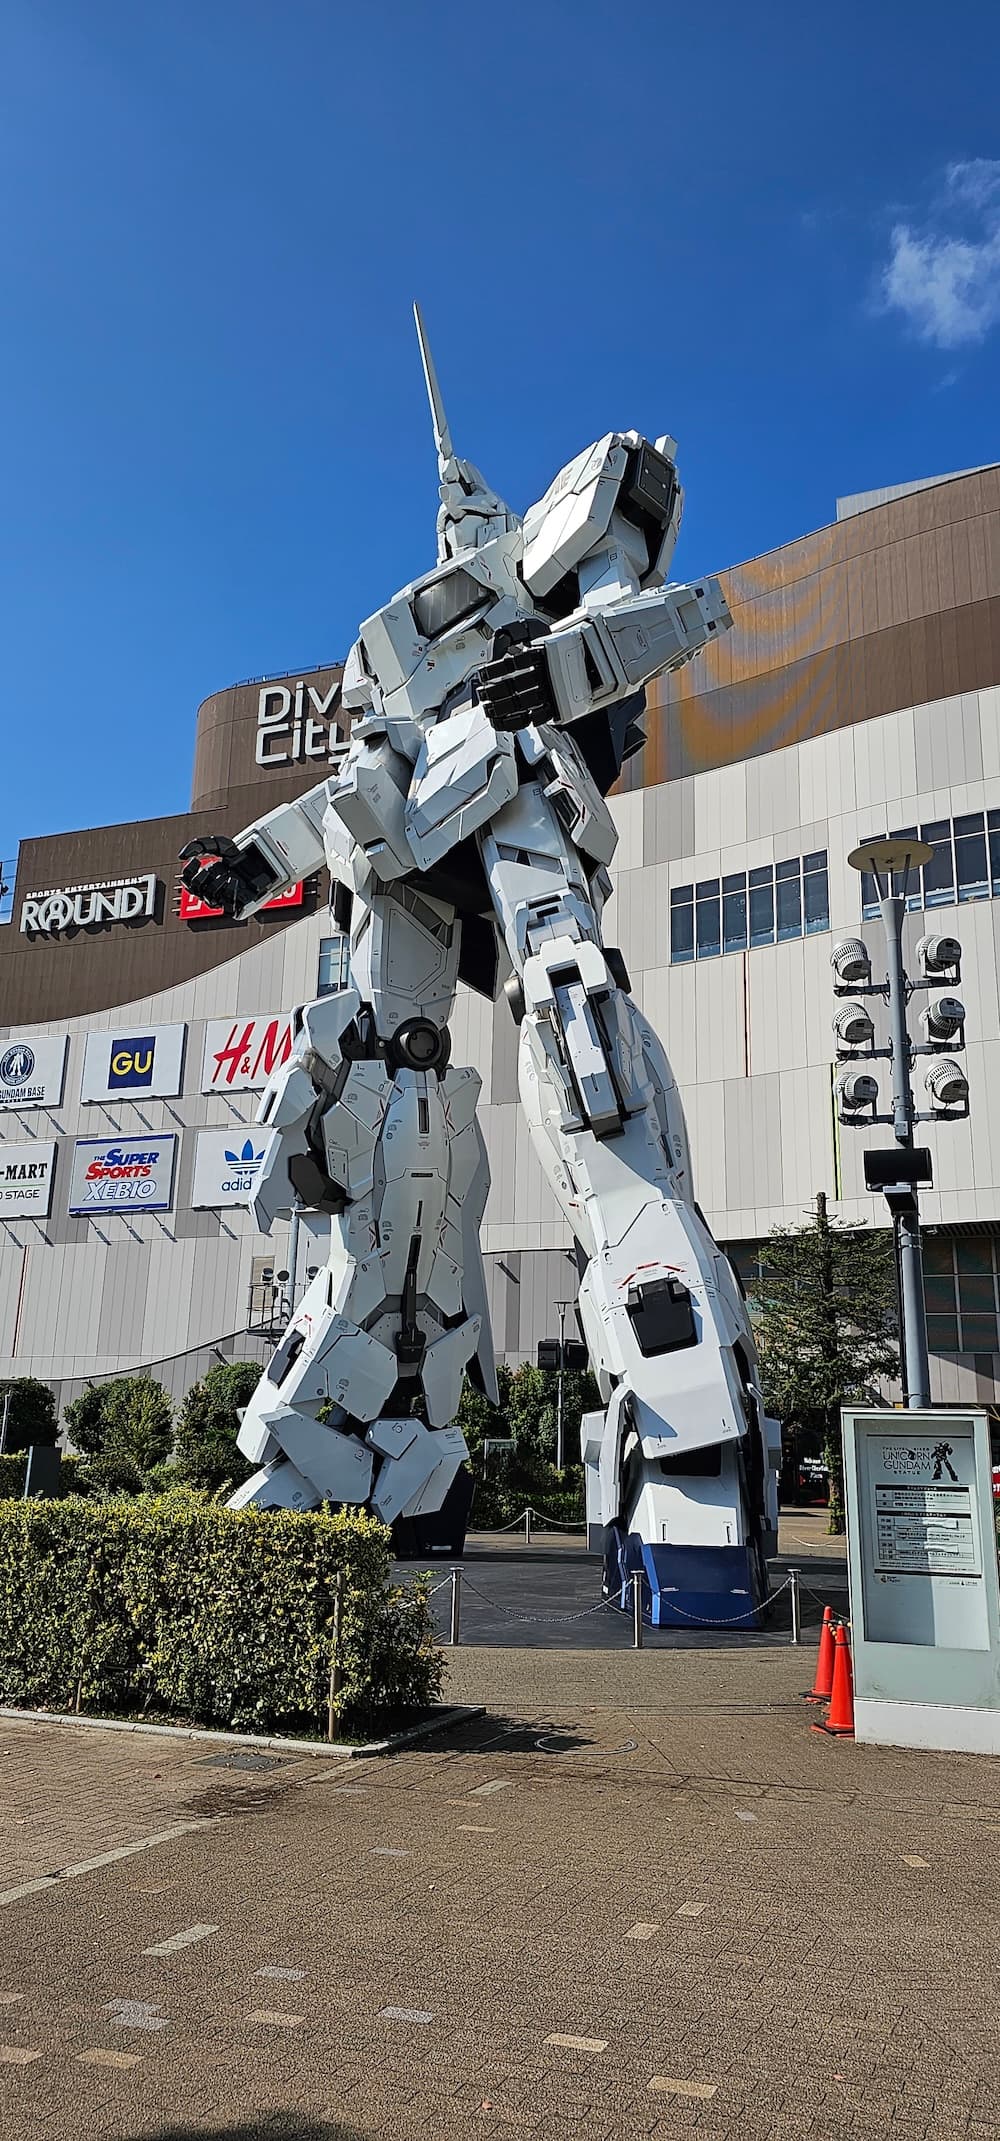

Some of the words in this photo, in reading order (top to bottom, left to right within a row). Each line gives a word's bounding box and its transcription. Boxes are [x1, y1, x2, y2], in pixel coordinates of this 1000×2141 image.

[258, 681, 340, 725] Div
[256, 718, 359, 765] City
[26, 889, 61, 899] SPORTS
[64, 876, 146, 894] ENTERTAINMENT
[20, 873, 156, 933] ROUND1
[213, 1020, 292, 1084] H&M
[112, 1051, 152, 1076] GU
[27, 1086, 45, 1097] BASE
[104, 1148, 160, 1167] SUPER
[85, 1161, 152, 1180] SPORTS
[5, 1189, 40, 1200] STAGE
[83, 1179, 157, 1201] XEBIO
[221, 1178, 252, 1192] adid
[883, 1460, 931, 1470] GUNDAM
